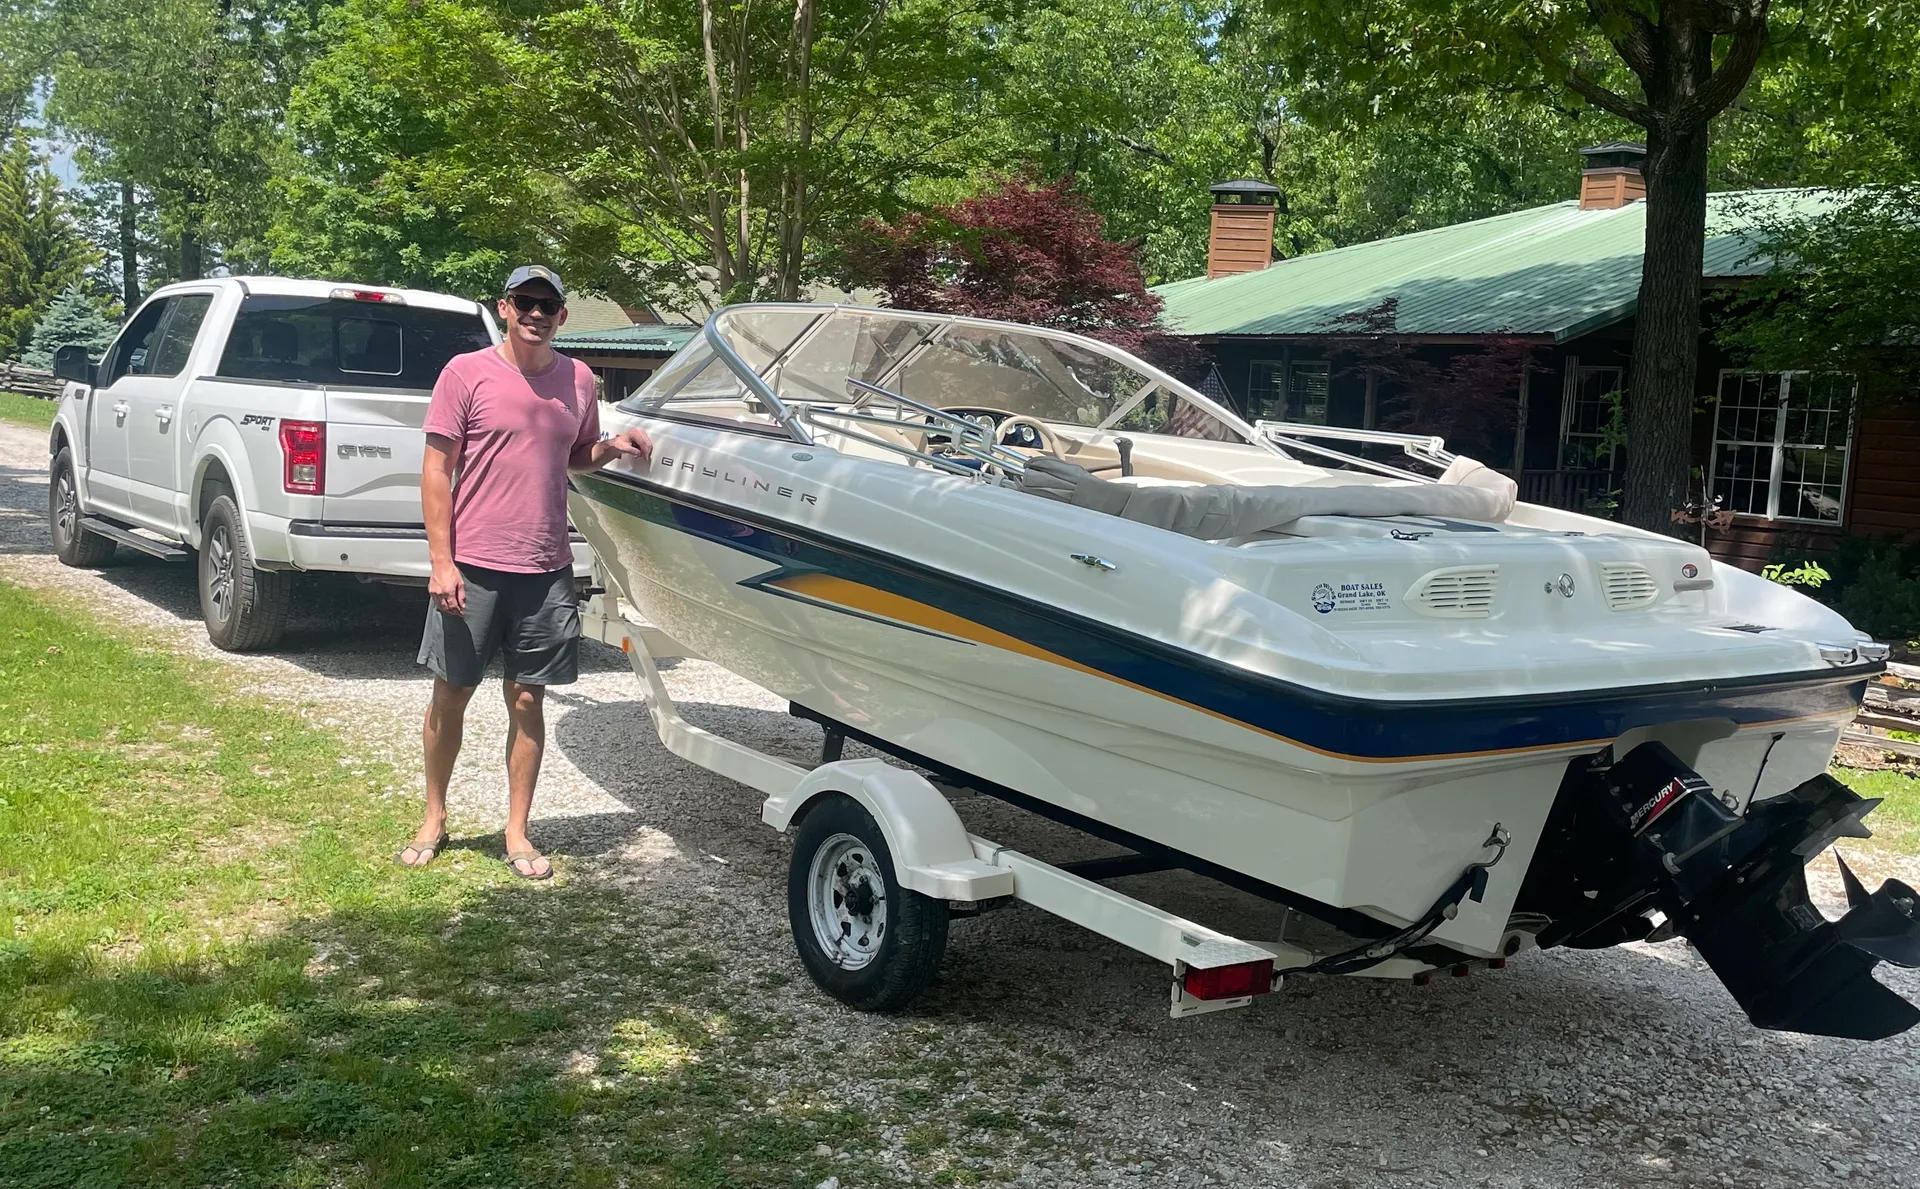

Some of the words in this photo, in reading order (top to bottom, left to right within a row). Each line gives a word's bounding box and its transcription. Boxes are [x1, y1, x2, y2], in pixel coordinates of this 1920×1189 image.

[240, 413, 276, 426] SPORT
[661, 456, 818, 506] BAYLINER
[1630, 781, 1674, 829] MERCURY
